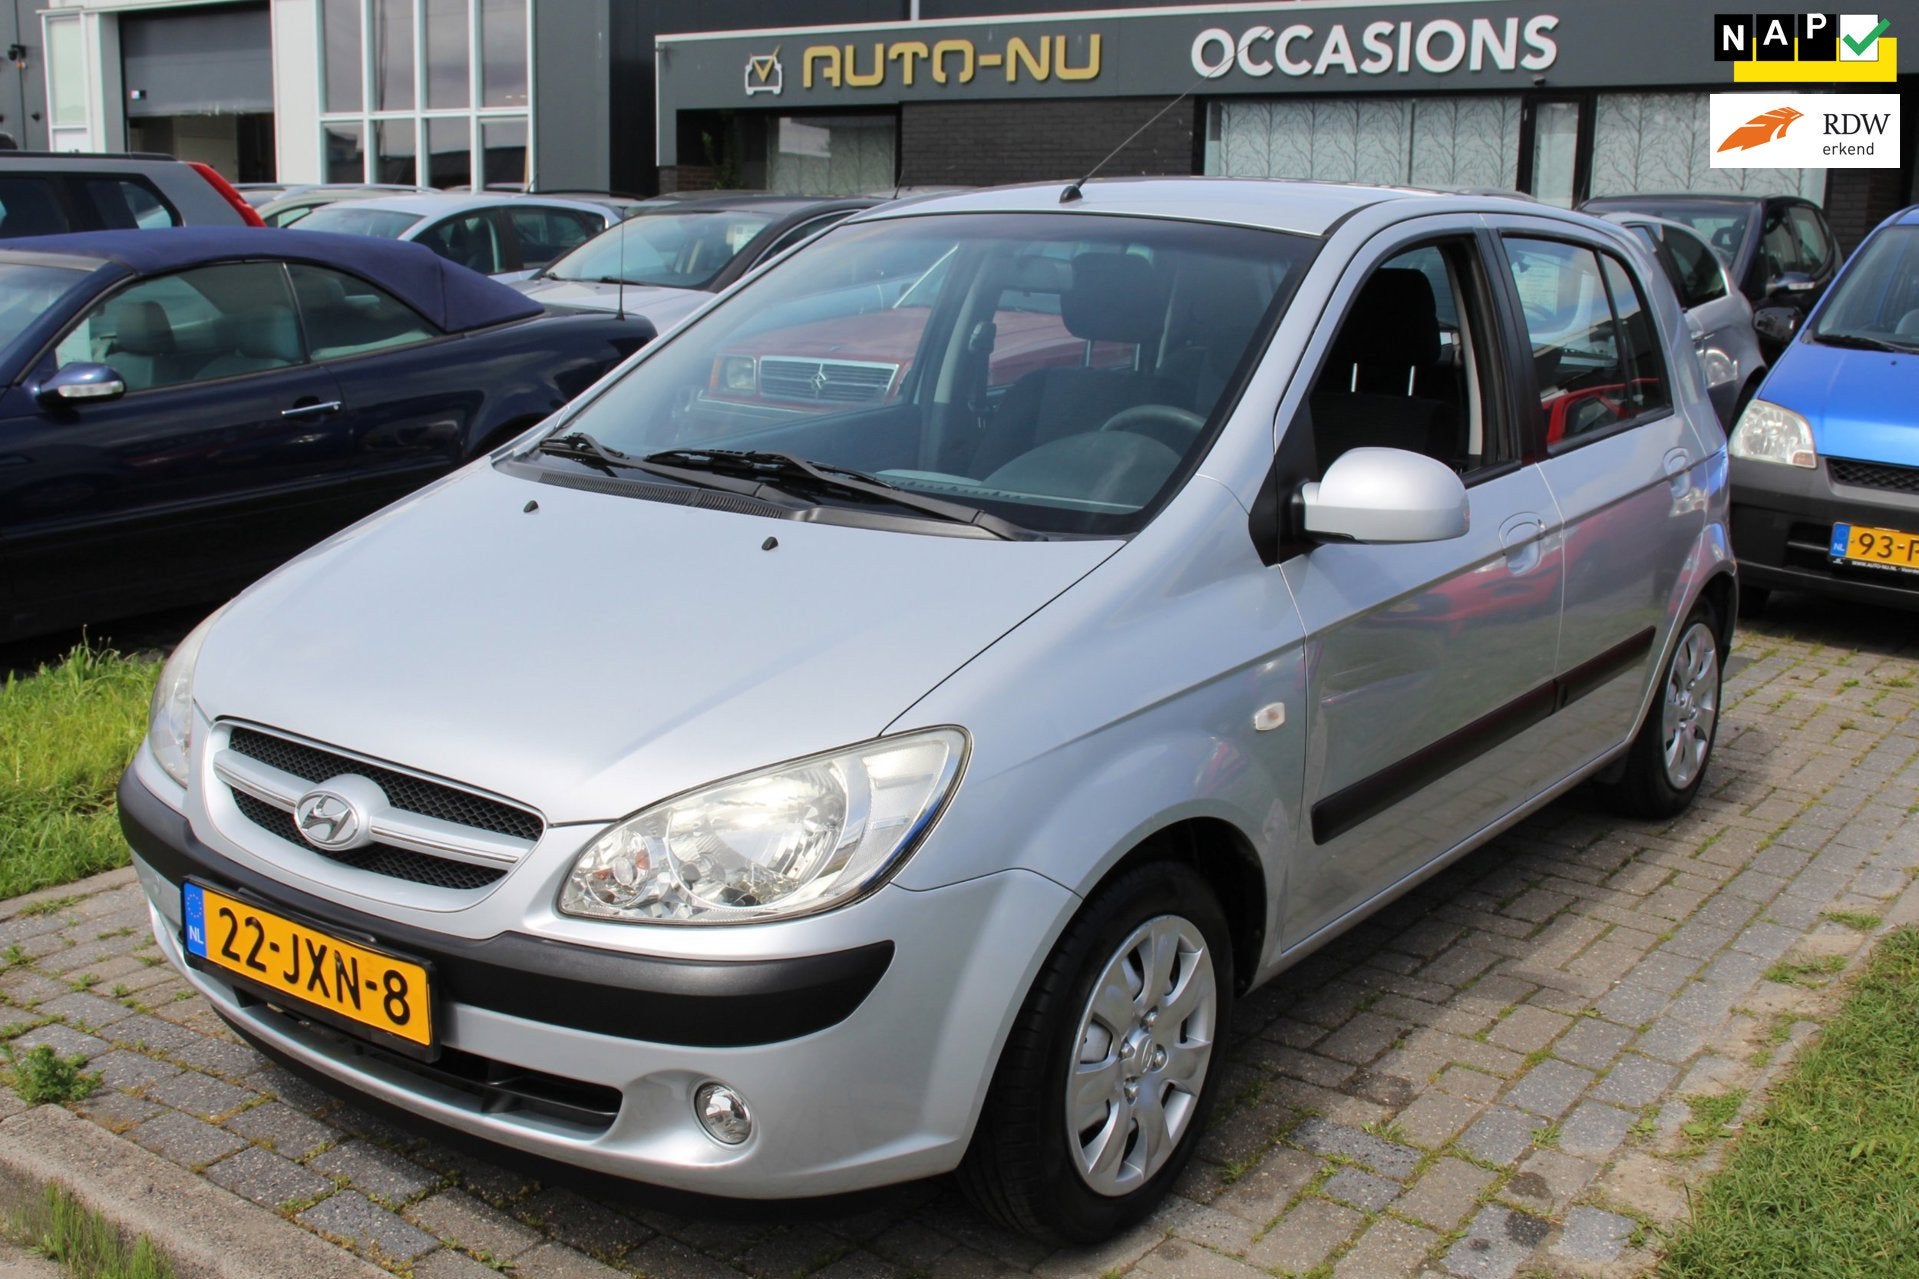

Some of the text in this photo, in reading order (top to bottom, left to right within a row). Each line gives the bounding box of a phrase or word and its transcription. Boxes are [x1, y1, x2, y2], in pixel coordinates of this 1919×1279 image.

[802, 14, 1560, 88] AUTO-NU OCCASIONS
[1833, 543, 1846, 552] NL
[188, 925, 205, 945] NL
[218, 907, 411, 1026] 22-JXN-8
